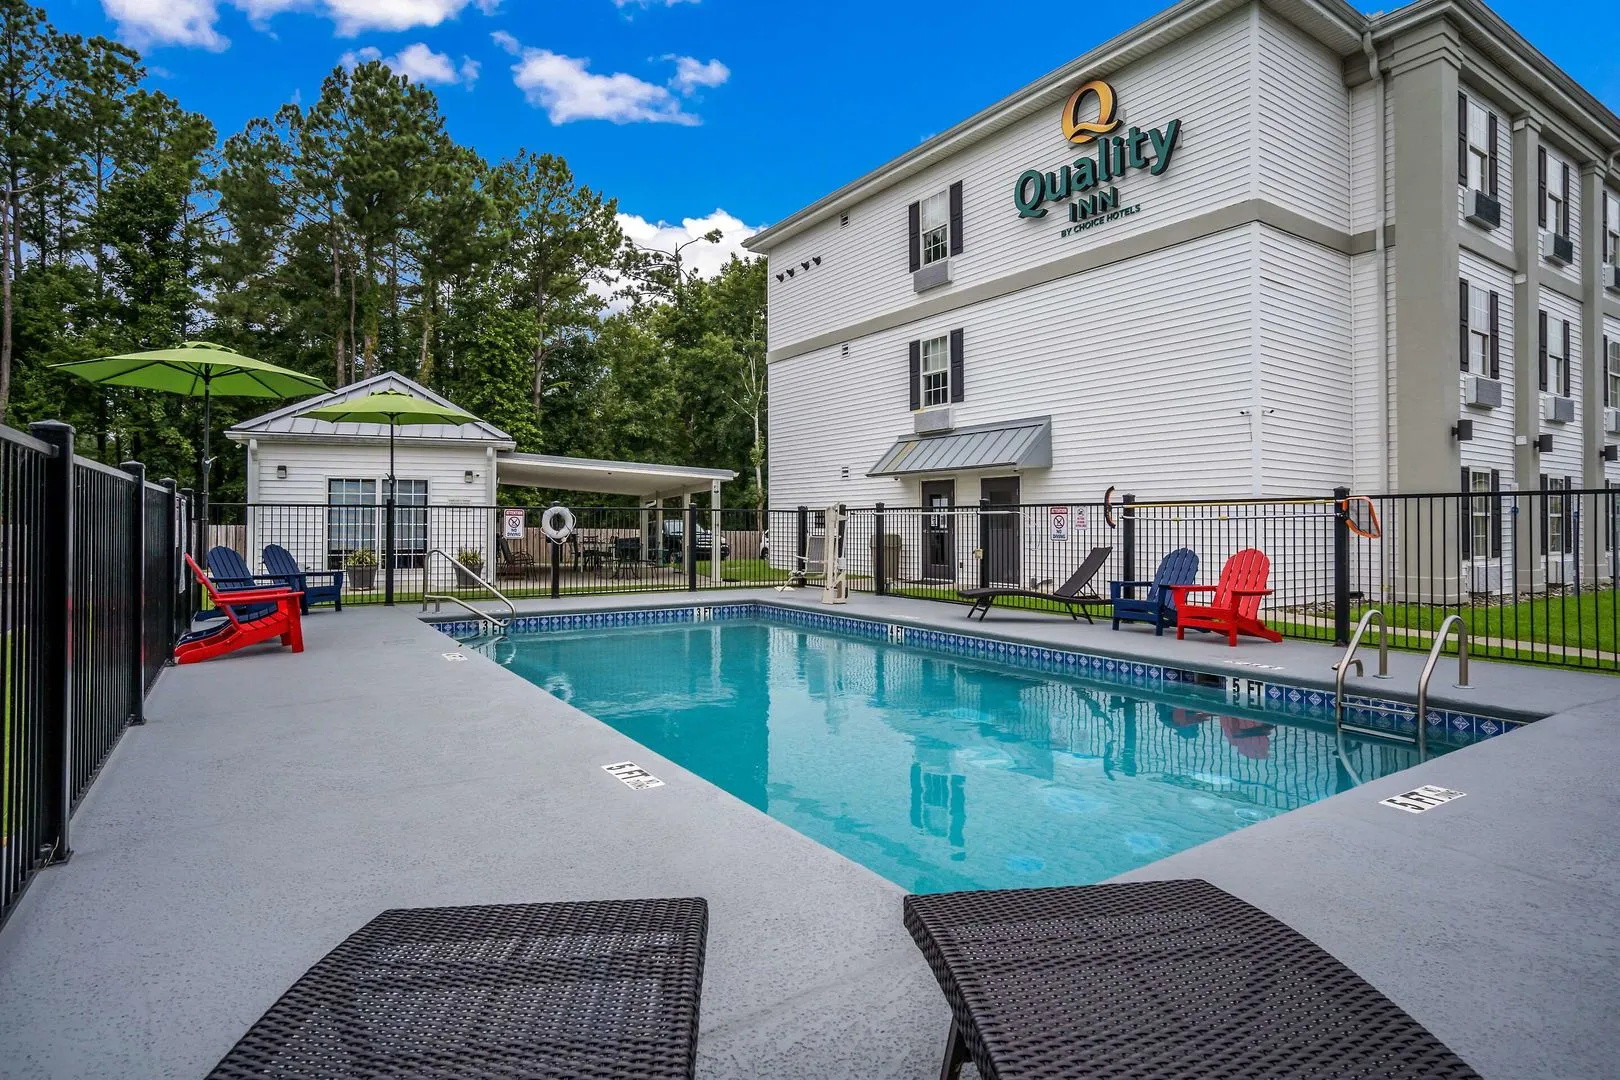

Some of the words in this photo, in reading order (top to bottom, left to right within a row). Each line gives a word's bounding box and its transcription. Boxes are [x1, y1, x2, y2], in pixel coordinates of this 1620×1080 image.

[1061, 80, 1124, 144] Q
[1014, 119, 1182, 218] Quality
[1069, 186, 1119, 222] INN
[1061, 228, 1073, 238] BY
[1073, 215, 1105, 233] CHOICE
[1107, 204, 1141, 222] HOTELS
[696, 607, 701, 616] 3
[704, 606, 712, 616] FT
[482, 620, 488, 630] 3
[1232, 677, 1240, 693] 5
[1247, 680, 1264, 697] FT
[606, 763, 635, 771] 5
[615, 769, 651, 780] FT
[1386, 799, 1425, 811] 5
[1400, 791, 1445, 806] FT
